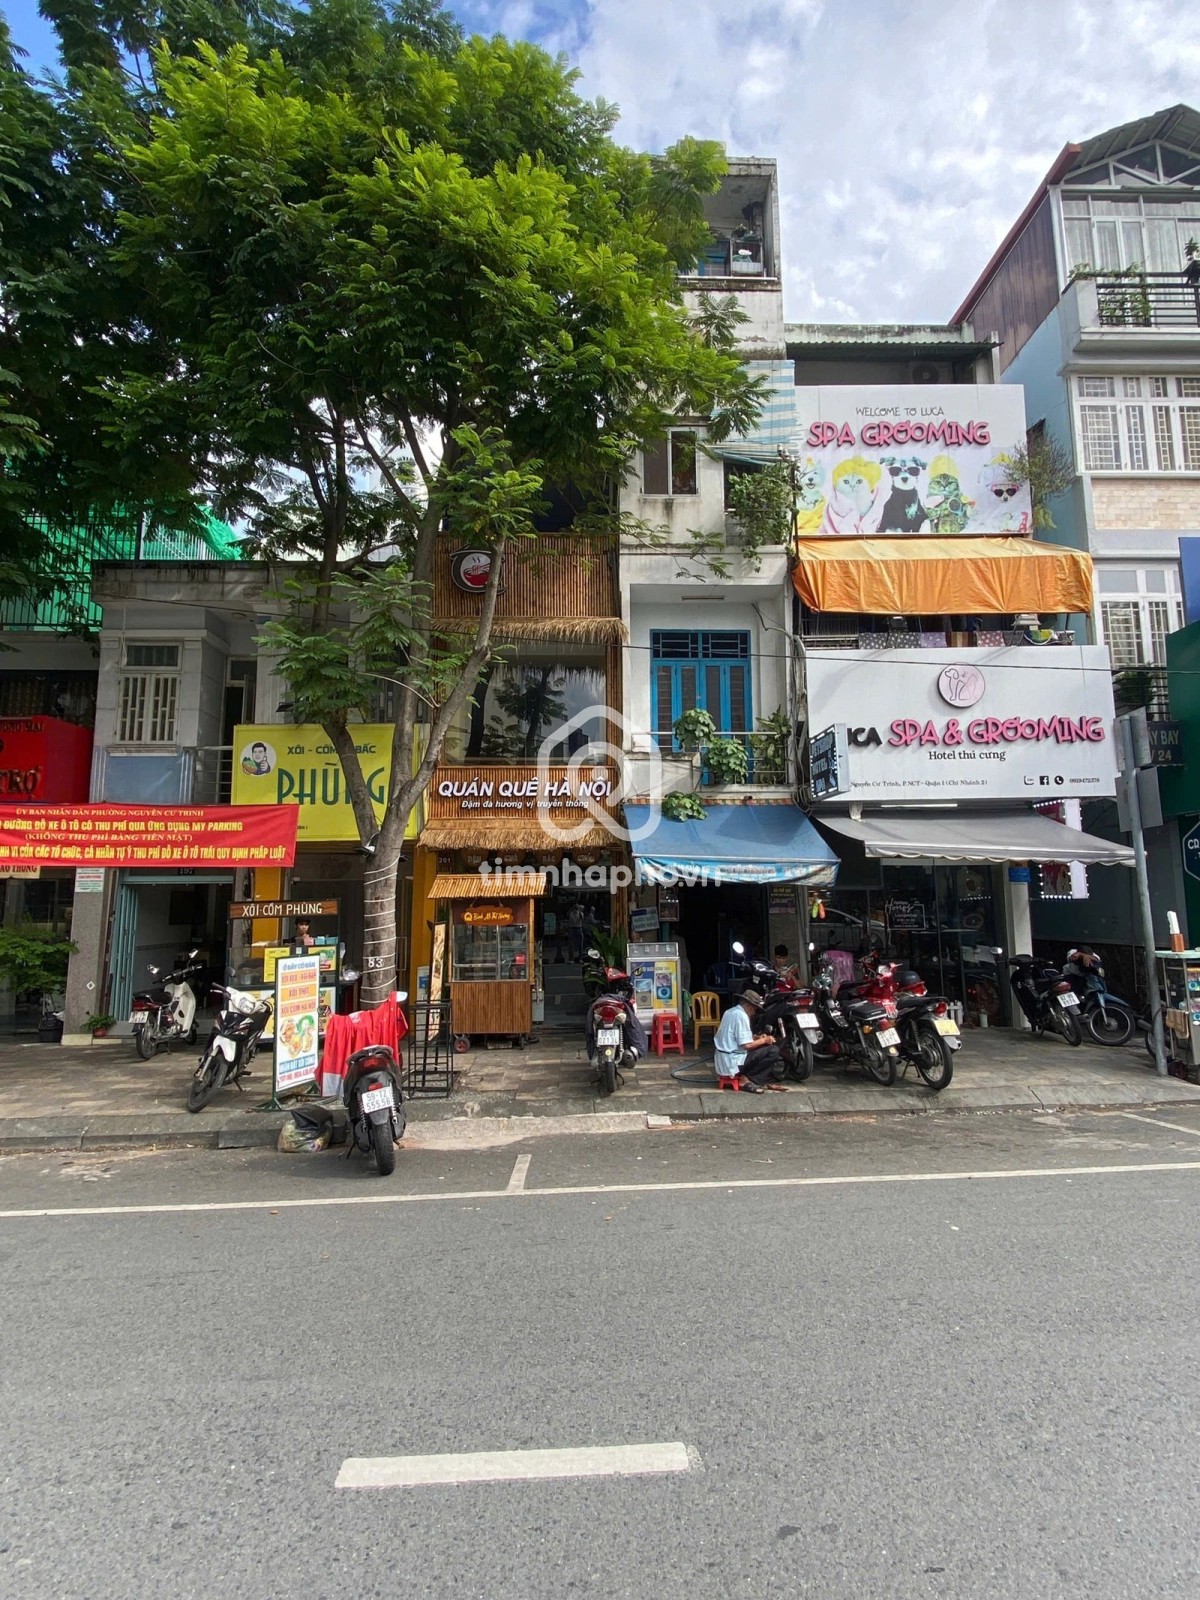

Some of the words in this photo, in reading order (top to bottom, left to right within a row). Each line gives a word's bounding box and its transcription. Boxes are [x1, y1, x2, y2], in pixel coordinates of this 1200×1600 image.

[855, 406, 900, 417] WELCOME
[904, 406, 917, 416] TO
[920, 406, 944, 416] LUCA
[806, 420, 856, 447] SPA
[860, 418, 992, 447] GROOMING
[887, 718, 941, 746] SPA
[943, 717, 963, 746] &
[967, 714, 1106, 745] GROOMING
[1160, 730, 1180, 745] BAY
[287, 744, 305, 755] XÔI
[928, 750, 957, 760] Hotel
[958, 749, 976, 760] thú
[978, 751, 1006, 762] cưng
[1157, 750, 1172, 761] 24
[438, 776, 494, 798] QUÁN
[498, 776, 539, 798] QUÊ
[544, 776, 571, 797] HÀ
[578, 776, 612, 801] NỘI
[461, 800, 481, 810] Đậm
[482, 799, 493, 808] đà
[495, 800, 522, 810] hương
[526, 801, 534, 809] vị
[47, 807, 71, 816] NHÂN
[72, 807, 90, 816] DÂN
[91, 808, 127, 816] PHƯỜNG
[128, 808, 163, 817] NGUYỄN
[164, 809, 178, 817] CƯ
[179, 809, 204, 817] TRINH
[3, 818, 33, 831] ĐƯỜNG
[34, 817, 46, 831] ĐỖ
[48, 820, 59, 831] XE
[61, 818, 67, 831] Ô
[69, 818, 79, 831] TÔ
[81, 819, 93, 831] CÓ
[95, 821, 111, 831] THU
[112, 819, 127, 831] PHÍ
[128, 821, 146, 831] QUA
[147, 819, 166, 831] ỨNG
[167, 821, 190, 833] DỤNG
[192, 821, 206, 831] MY
[207, 821, 243, 832] PARKING
[25, 832, 66, 841] (KHÔNG
[68, 833, 90, 841] THU
[91, 831, 109, 841] PHÍ
[34, 845, 50, 858] CÁC
[84, 845, 94, 858] CÁ
[95, 844, 115, 859] NHÂN
[133, 847, 147, 858] THU
[148, 845, 161, 858] PHÍ
[172, 847, 182, 859] XE
[182, 845, 188, 858] Ô
[190, 845, 199, 858] TÔ
[200, 845, 215, 859] TRÁI
[216, 847, 231, 859] QUY
[249, 845, 268, 859] PHÁP
[286, 901, 323, 915] PHÙNG
[367, 957, 384, 968] 83
